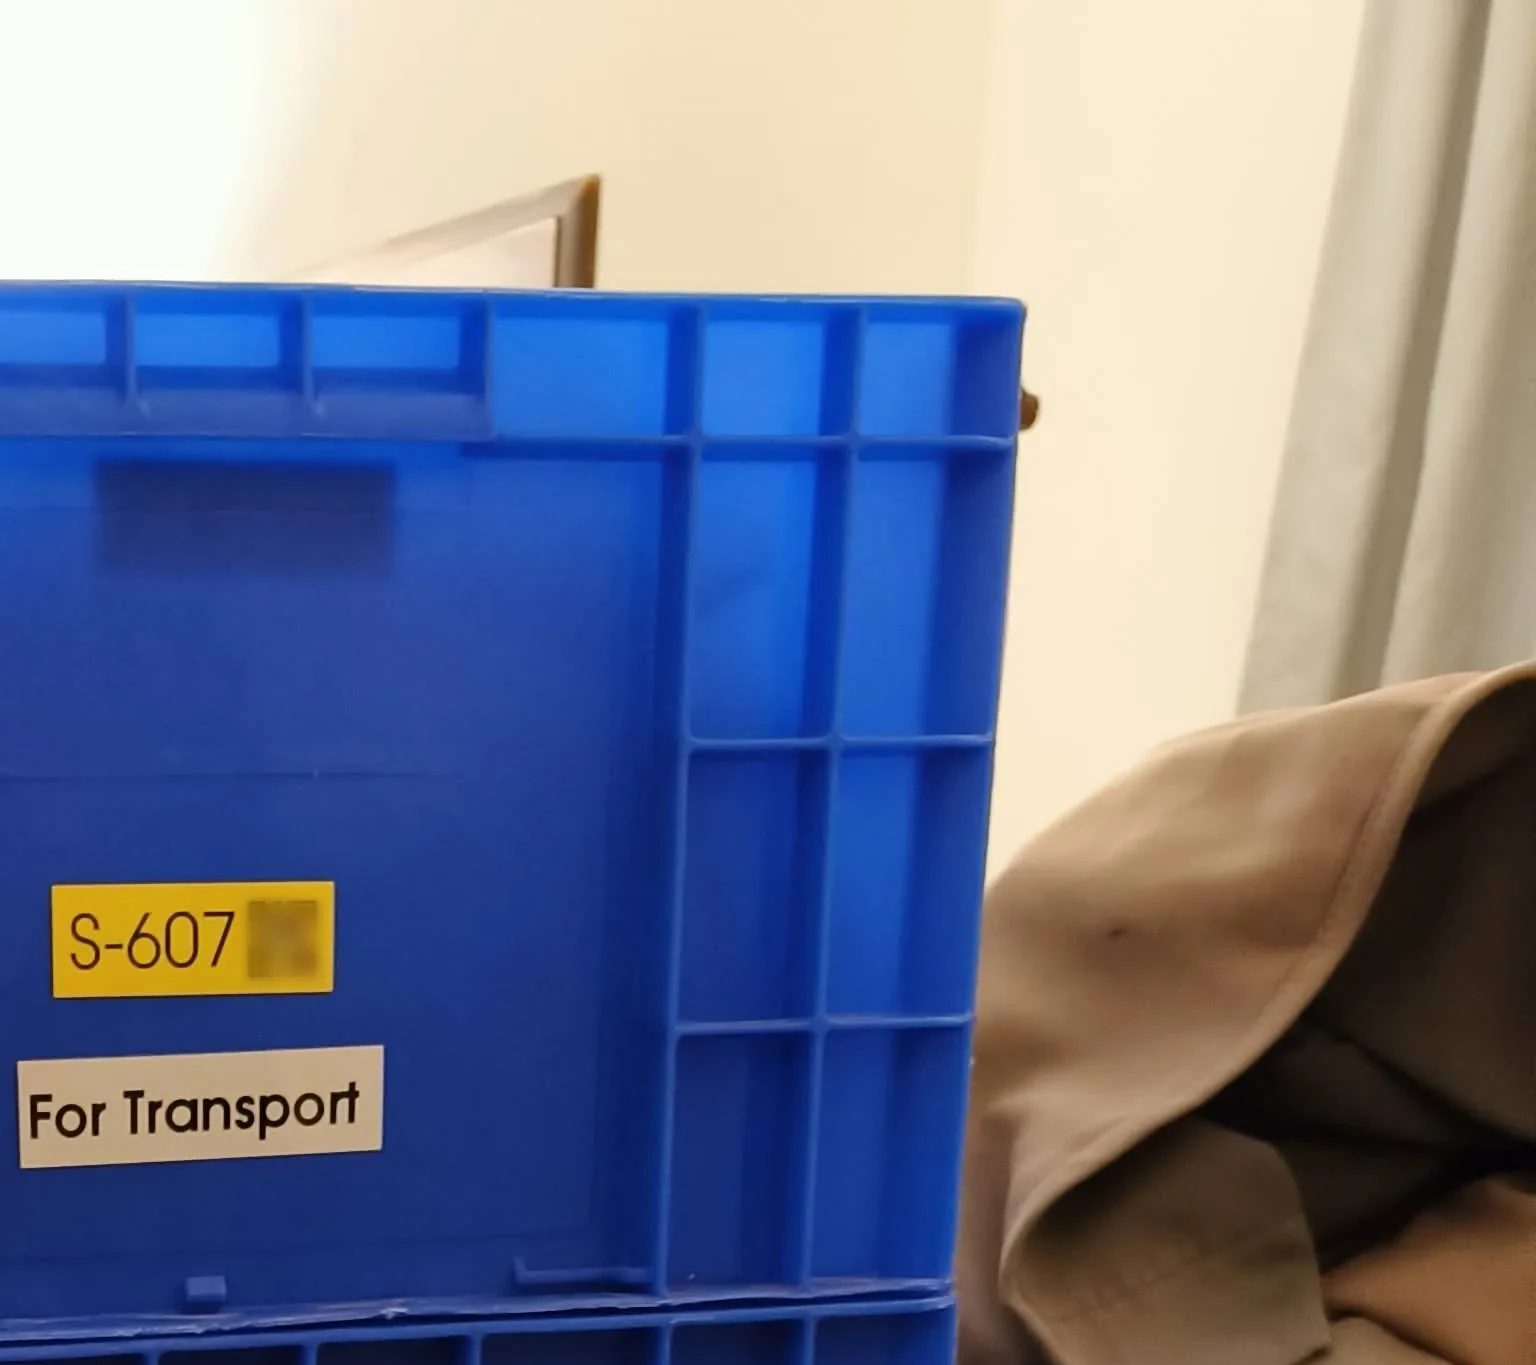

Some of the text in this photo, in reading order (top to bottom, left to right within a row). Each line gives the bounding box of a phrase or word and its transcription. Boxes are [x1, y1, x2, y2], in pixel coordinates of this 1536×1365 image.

[69, 910, 235, 970] S-607
[28, 1081, 360, 1140] For Transport
